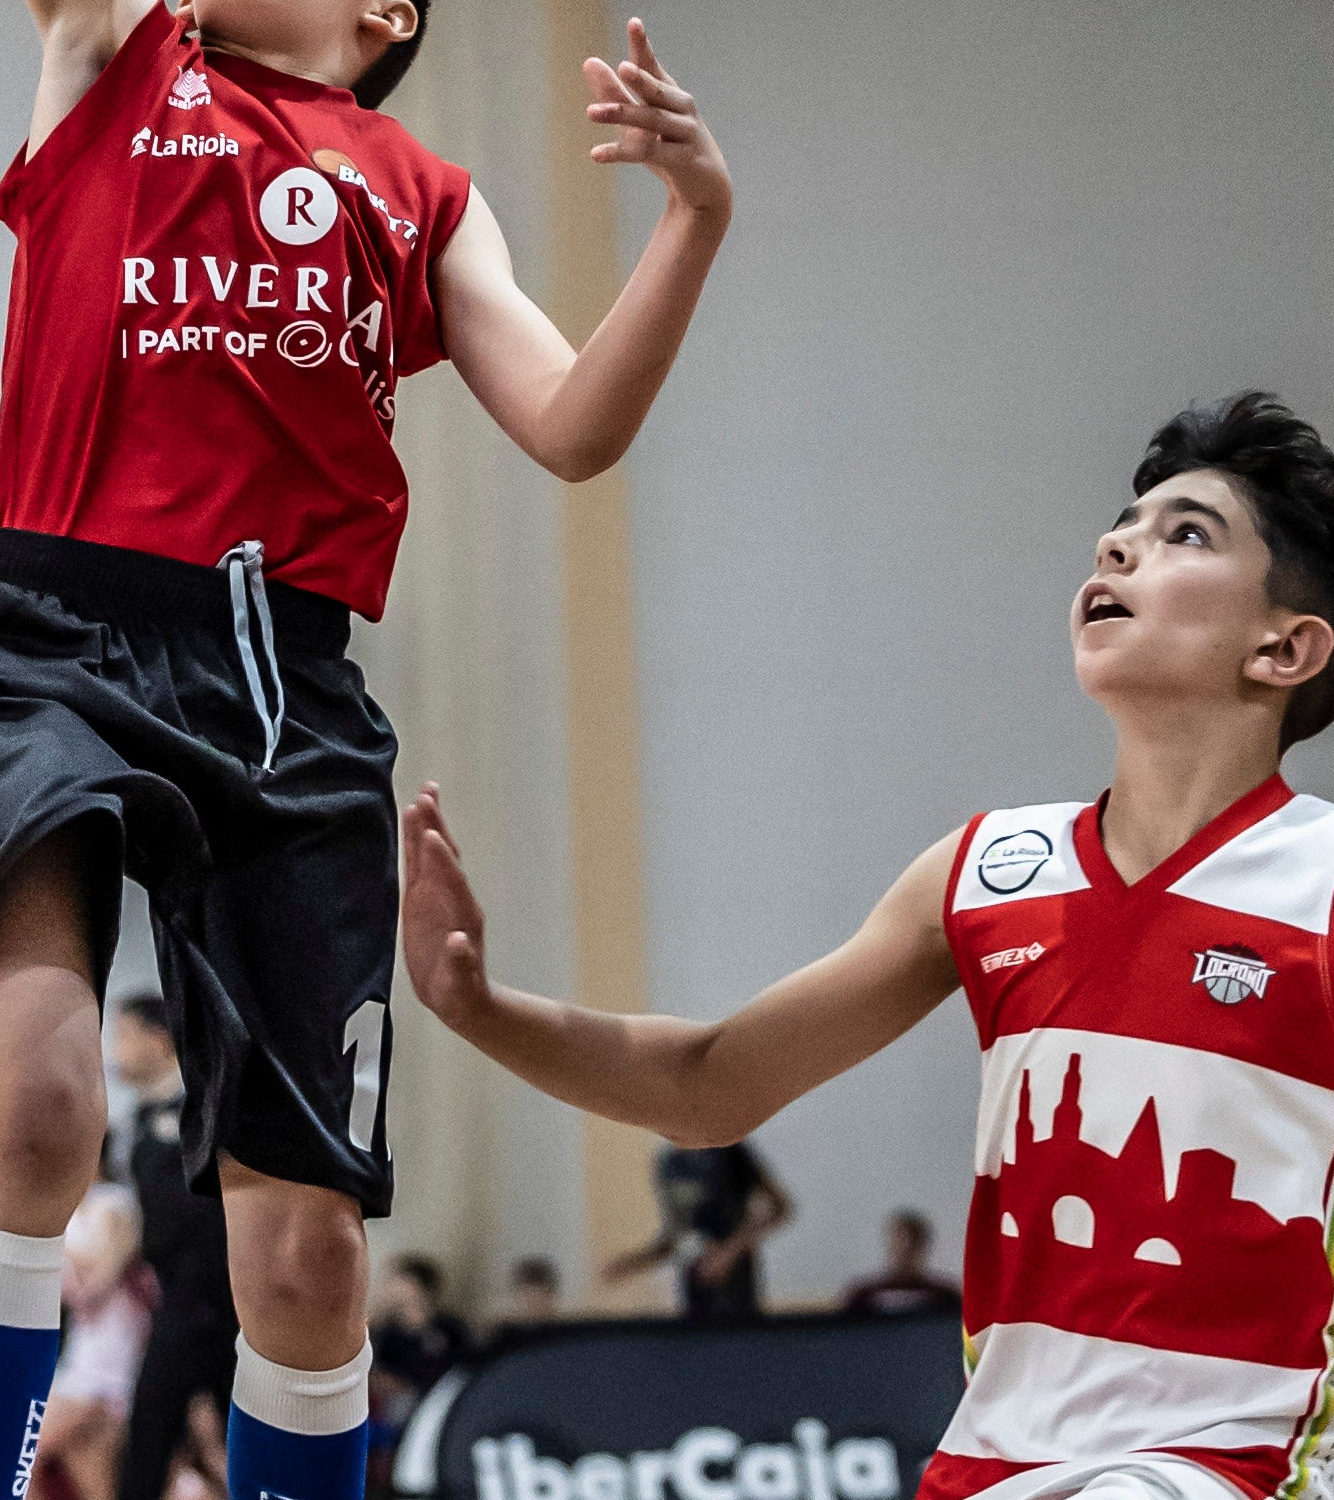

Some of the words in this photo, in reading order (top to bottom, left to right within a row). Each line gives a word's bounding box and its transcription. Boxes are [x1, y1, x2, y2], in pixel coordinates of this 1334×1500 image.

[151, 134, 178, 157] La
[181, 132, 239, 157] Rioja
[285, 187, 318, 227] R
[138, 326, 220, 355] PART
[225, 330, 267, 358] OF
[342, 999, 392, 1162] 1
